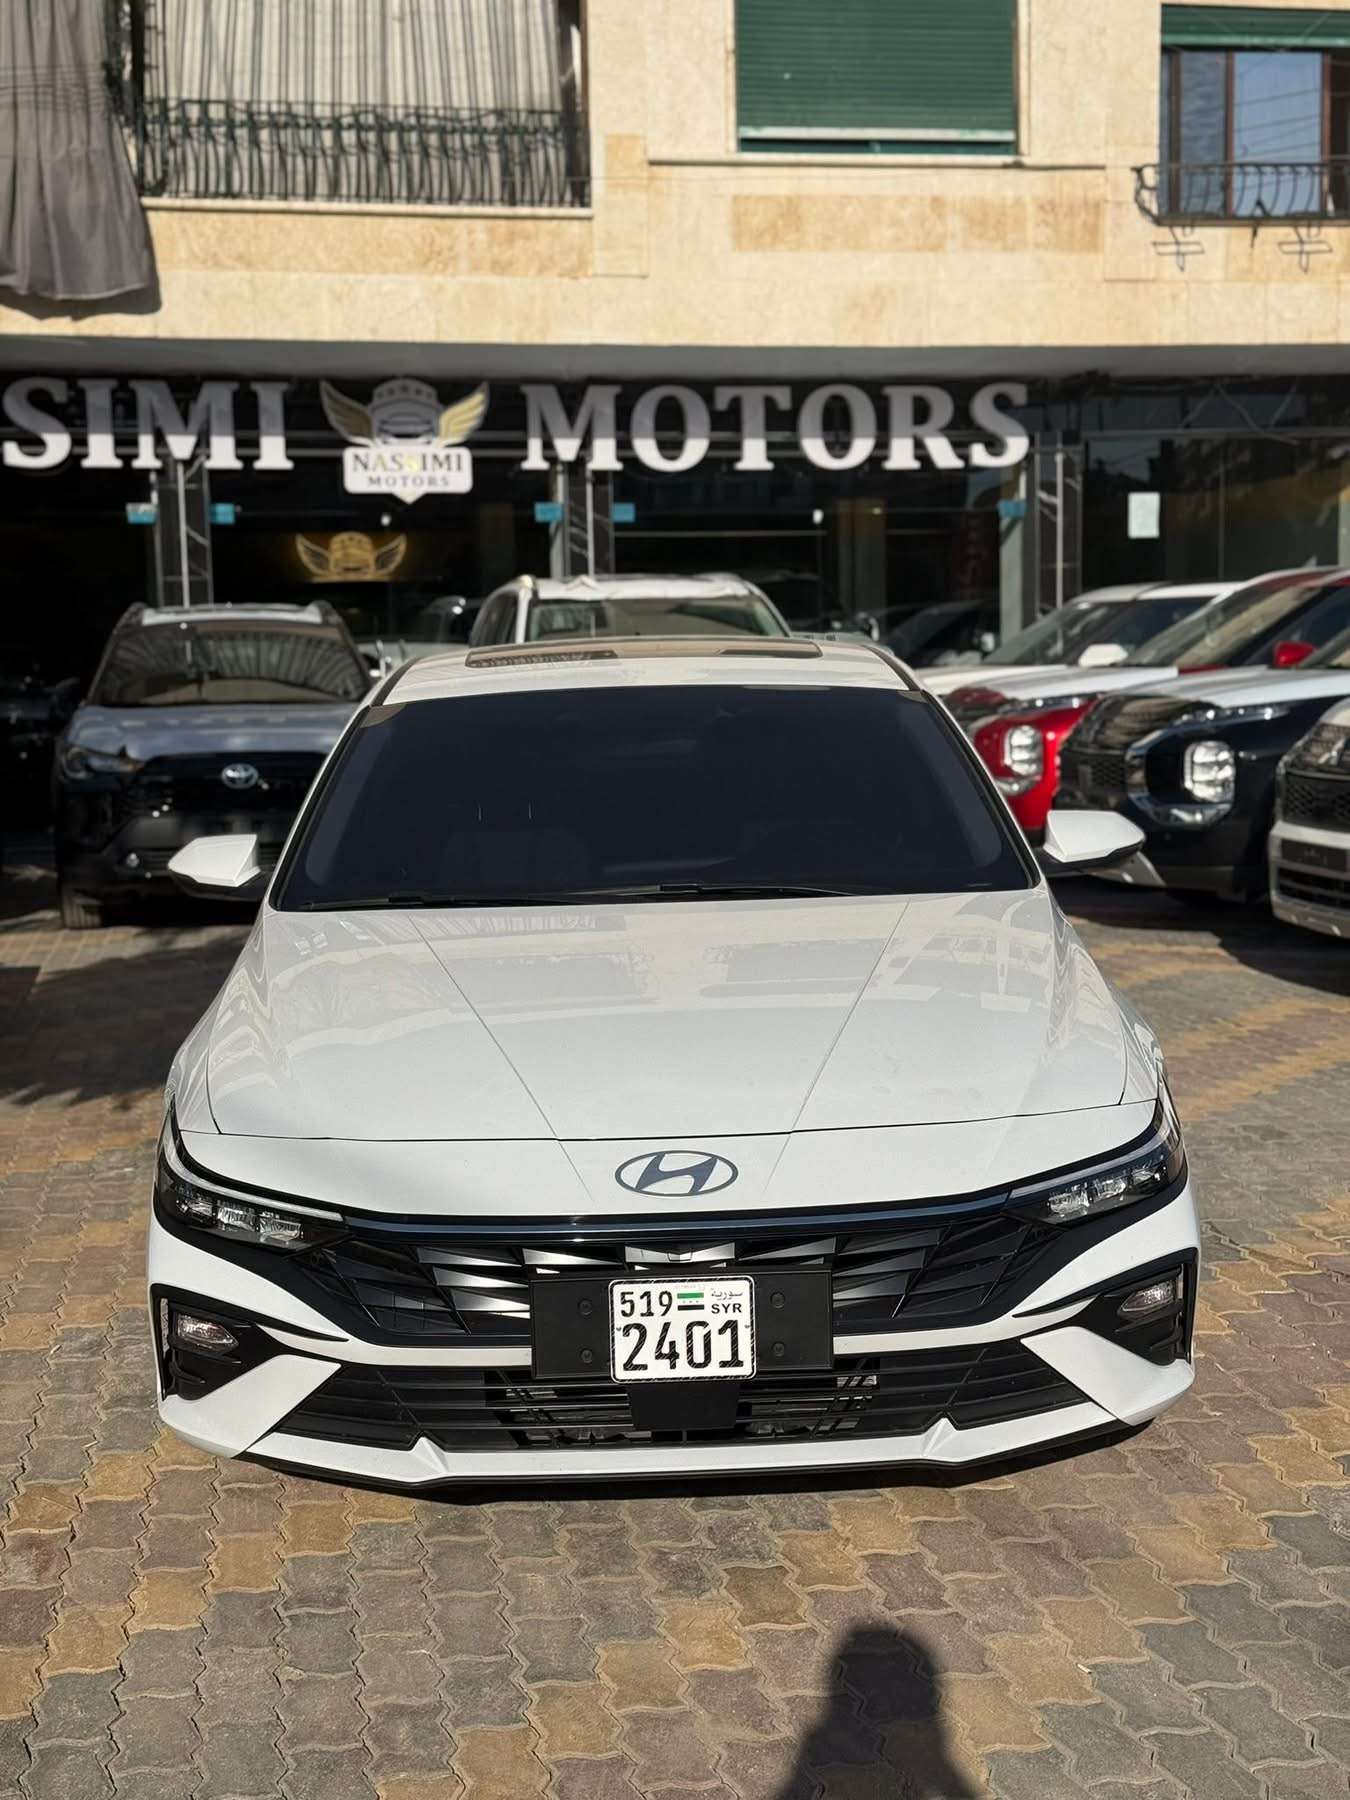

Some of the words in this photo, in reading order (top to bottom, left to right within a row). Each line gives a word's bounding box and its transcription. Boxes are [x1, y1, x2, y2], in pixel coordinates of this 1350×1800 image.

[2, 376, 294, 470] SIMI
[520, 382, 1029, 472] MOTORS
[368, 475, 449, 488] MOTORS
[620, 1290, 673, 1317] 519
[711, 1303, 742, 1314] SYR
[622, 1320, 744, 1371] 2401
